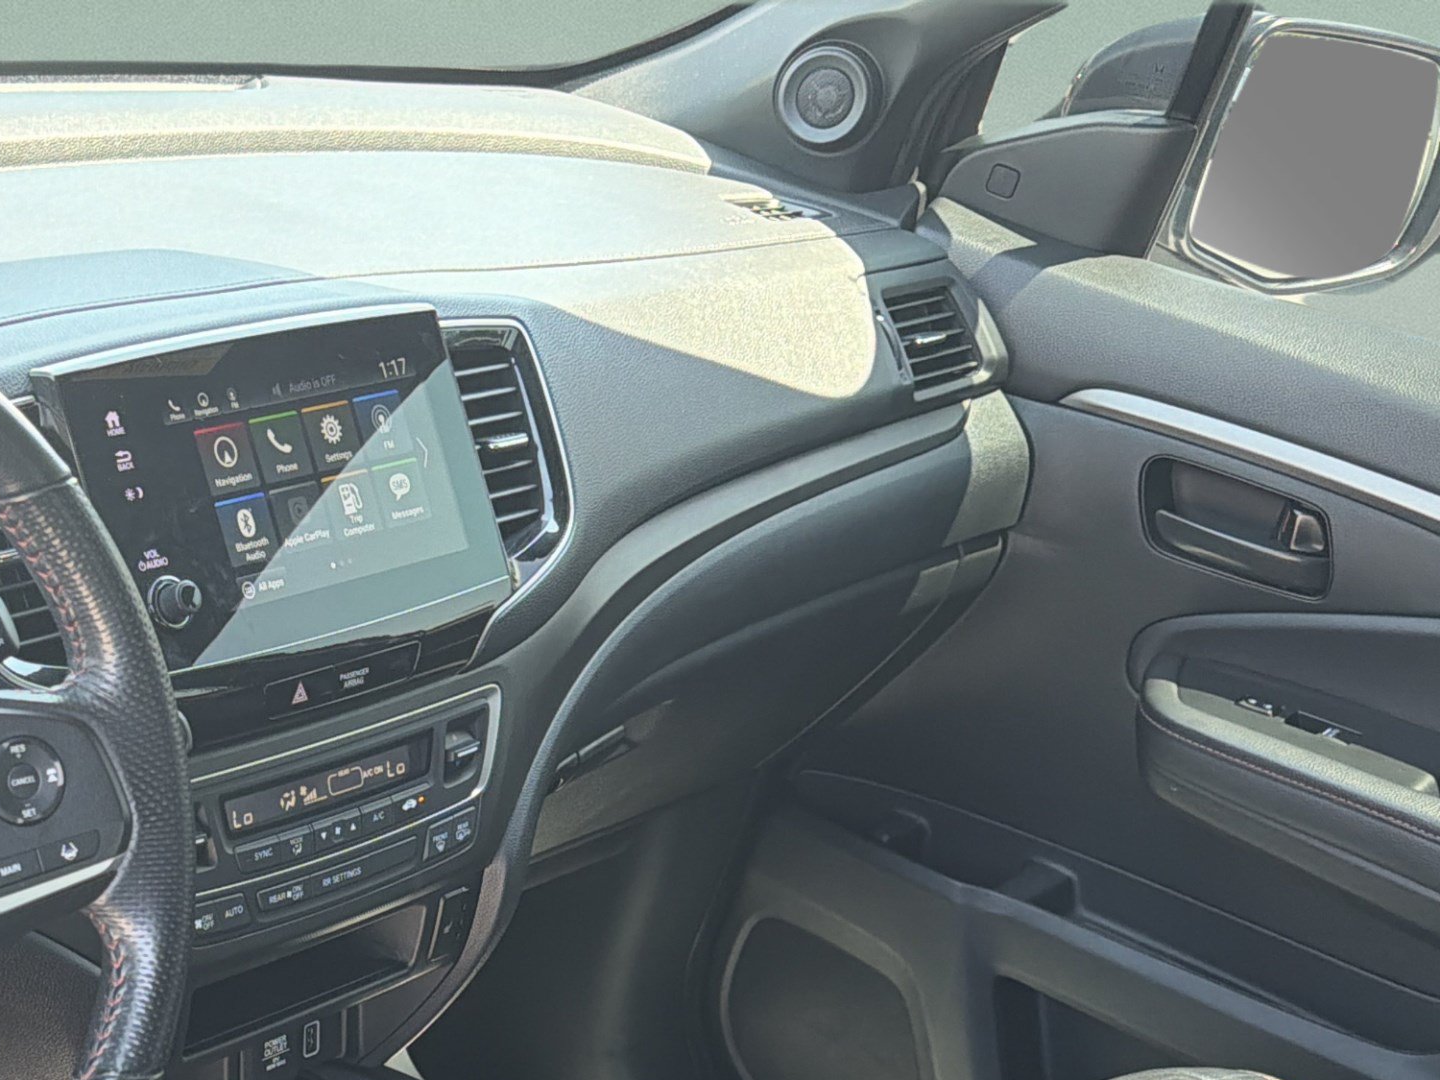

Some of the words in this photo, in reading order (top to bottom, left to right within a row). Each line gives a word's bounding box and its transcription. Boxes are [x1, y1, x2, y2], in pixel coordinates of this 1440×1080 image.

[378, 357, 407, 379] 1:17
[289, 380, 312, 393] Audio
[321, 374, 336, 387] OFF
[106, 427, 126, 437] HOME
[325, 450, 353, 463] Settings
[117, 461, 135, 472] BACK
[276, 463, 298, 474] Phone
[214, 472, 253, 488] Navigation
[391, 506, 424, 520] Messages
[343, 523, 375, 537] Computer
[234, 537, 269, 553] Bluetooth
[284, 535, 304, 548] Apple
[304, 529, 330, 542] CarPlay
[143, 549, 160, 560] VOL
[245, 550, 267, 561] Audio
[147, 556, 169, 570] AUDIO
[258, 582, 268, 592] All
[268, 579, 285, 591] Apps
[340, 667, 370, 681] PASSENGER
[344, 676, 364, 689] AIRBAG
[10, 743, 26, 754] RES
[386, 760, 405, 778] Lo
[11, 775, 36, 787] CANCEL
[22, 807, 37, 818] SET
[233, 810, 253, 829] Lo
[254, 847, 273, 861] SYNC
[0, 863, 22, 877] MAIN
[332, 867, 362, 885] SETTINGS
[268, 892, 286, 904] REAR
[225, 904, 244, 918] AUTO
[264, 1034, 287, 1049] POWER
[264, 1041, 288, 1057] OUTLET
